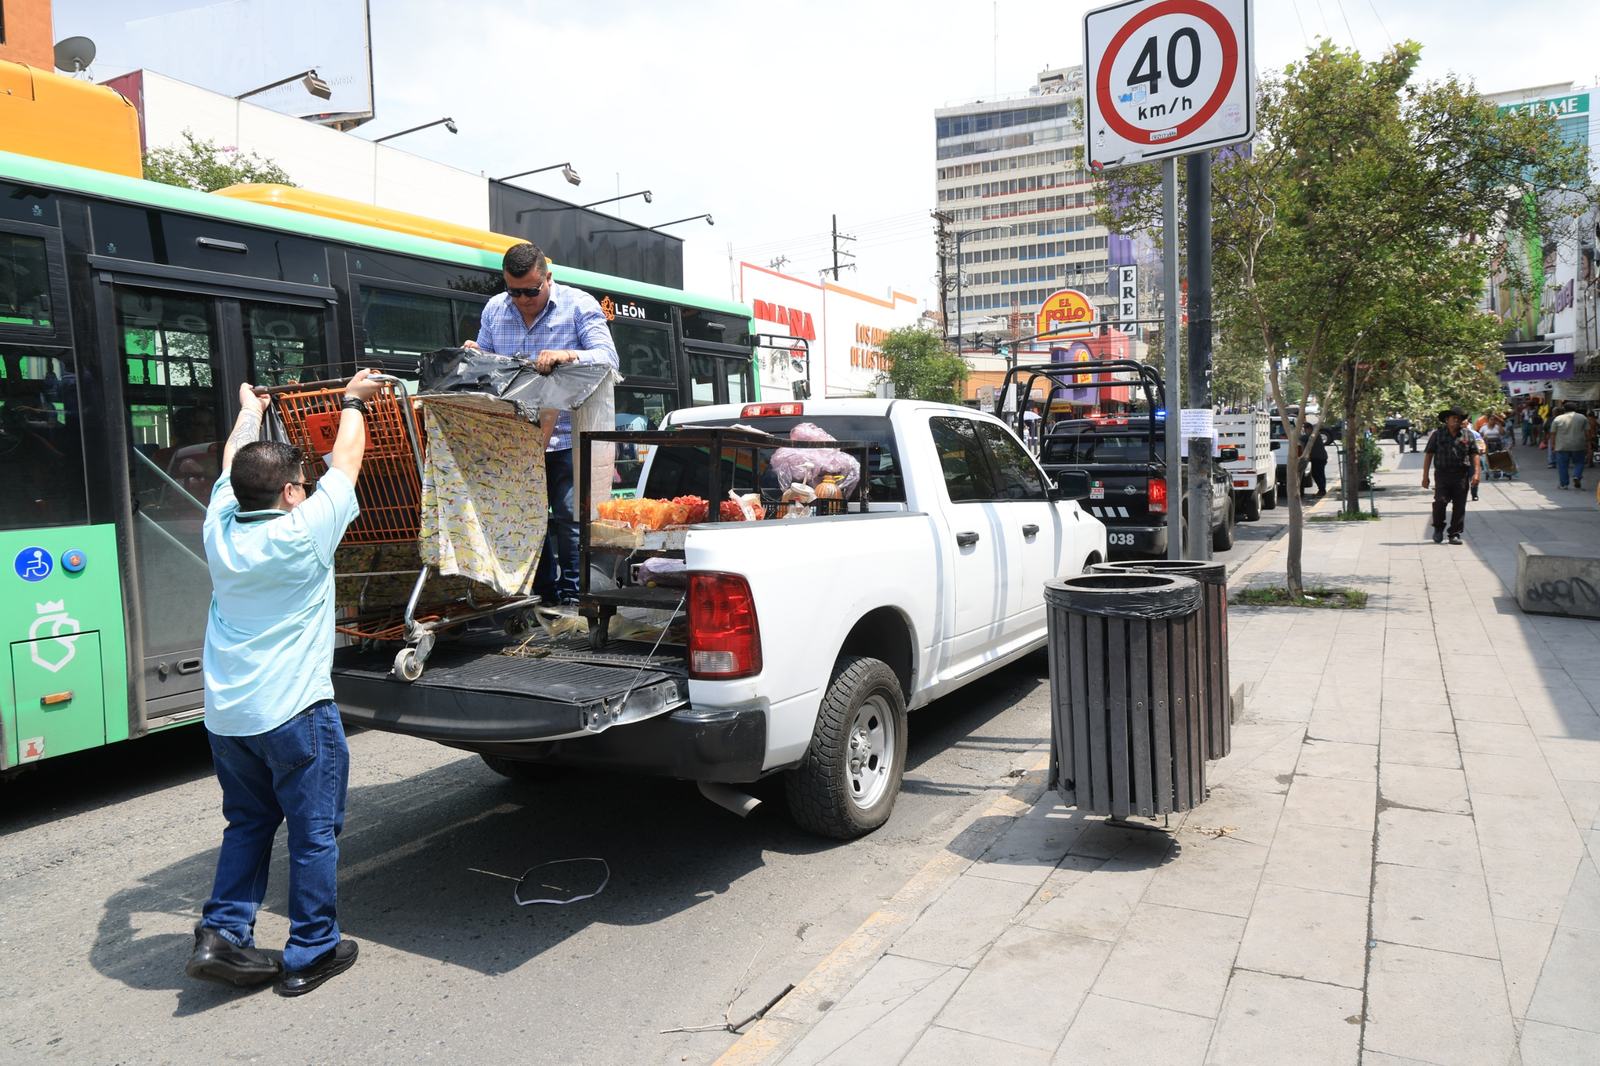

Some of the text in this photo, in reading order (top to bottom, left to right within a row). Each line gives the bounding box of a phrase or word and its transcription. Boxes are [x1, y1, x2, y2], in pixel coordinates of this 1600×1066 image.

[1127, 27, 1201, 95] 40
[1138, 96, 1192, 121] km/h
[1058, 298, 1072, 308] EL
[1046, 307, 1085, 322] POLLO
[1507, 360, 1567, 373] Vianney
[1108, 533, 1135, 546] 038
